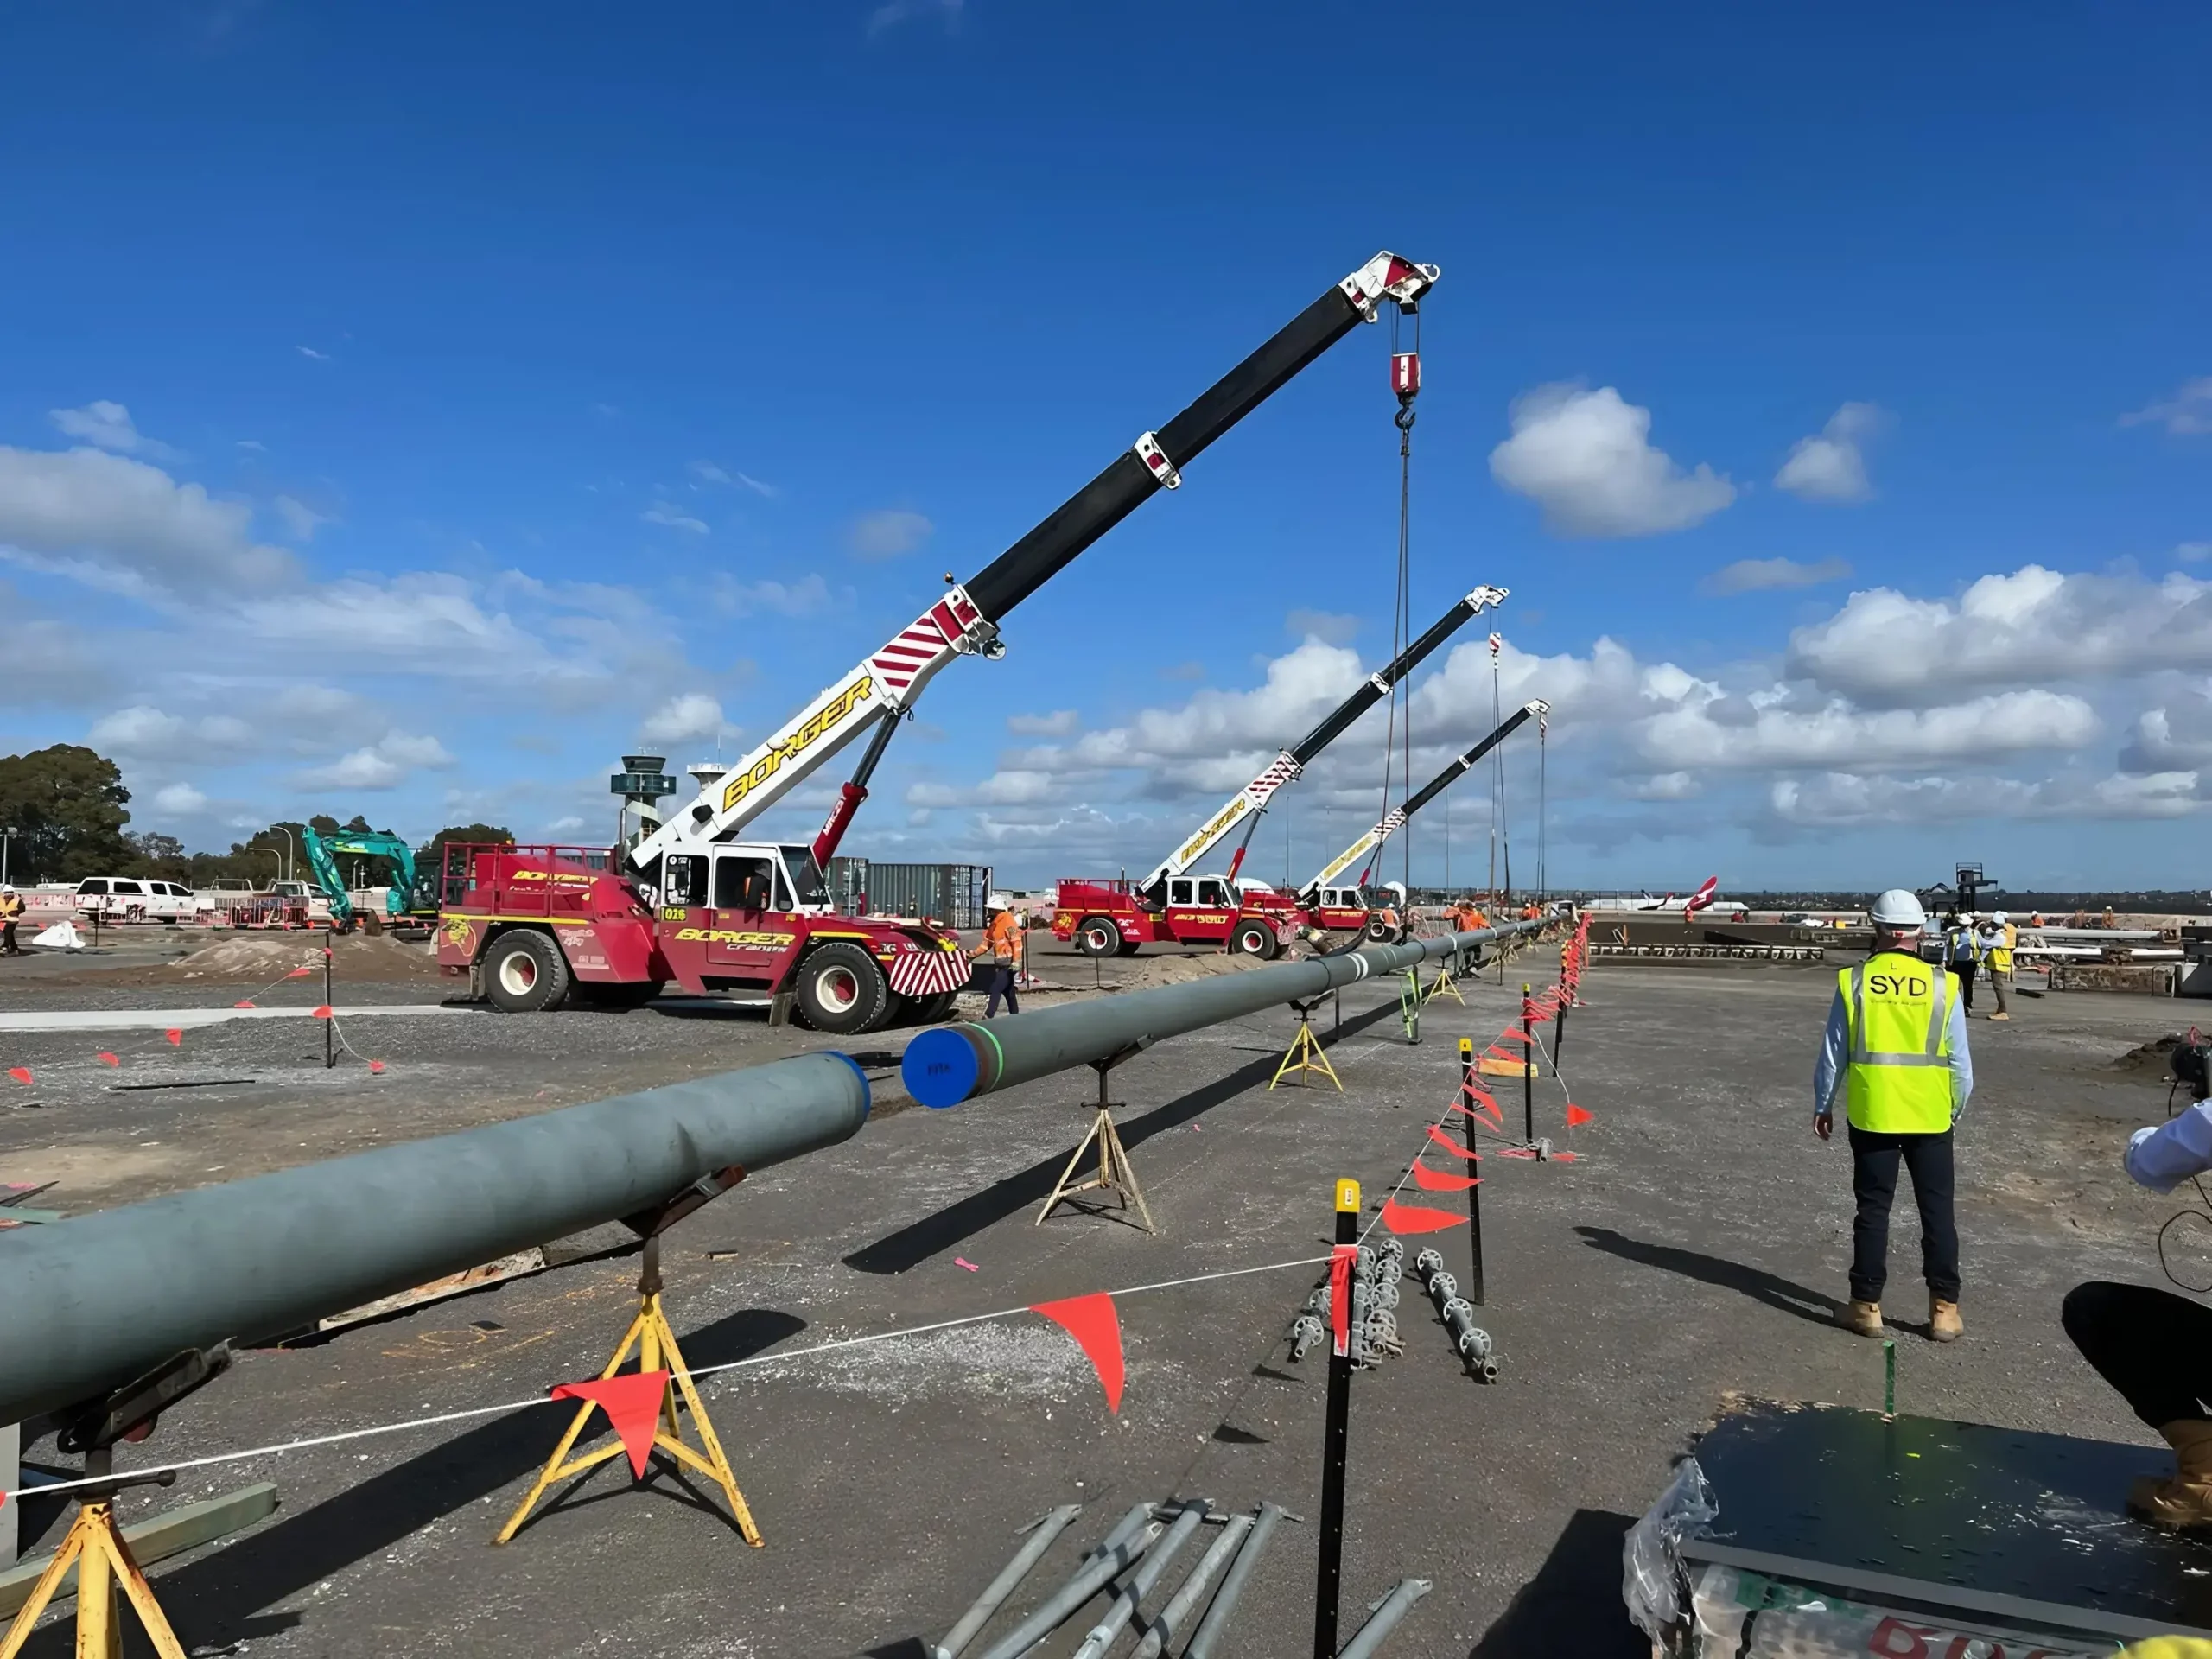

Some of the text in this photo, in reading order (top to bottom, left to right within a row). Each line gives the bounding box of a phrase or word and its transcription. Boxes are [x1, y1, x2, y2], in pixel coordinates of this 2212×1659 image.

[722, 676, 873, 813] BORGER
[674, 928, 796, 945] BORGER
[1869, 975, 1927, 996] SYD
